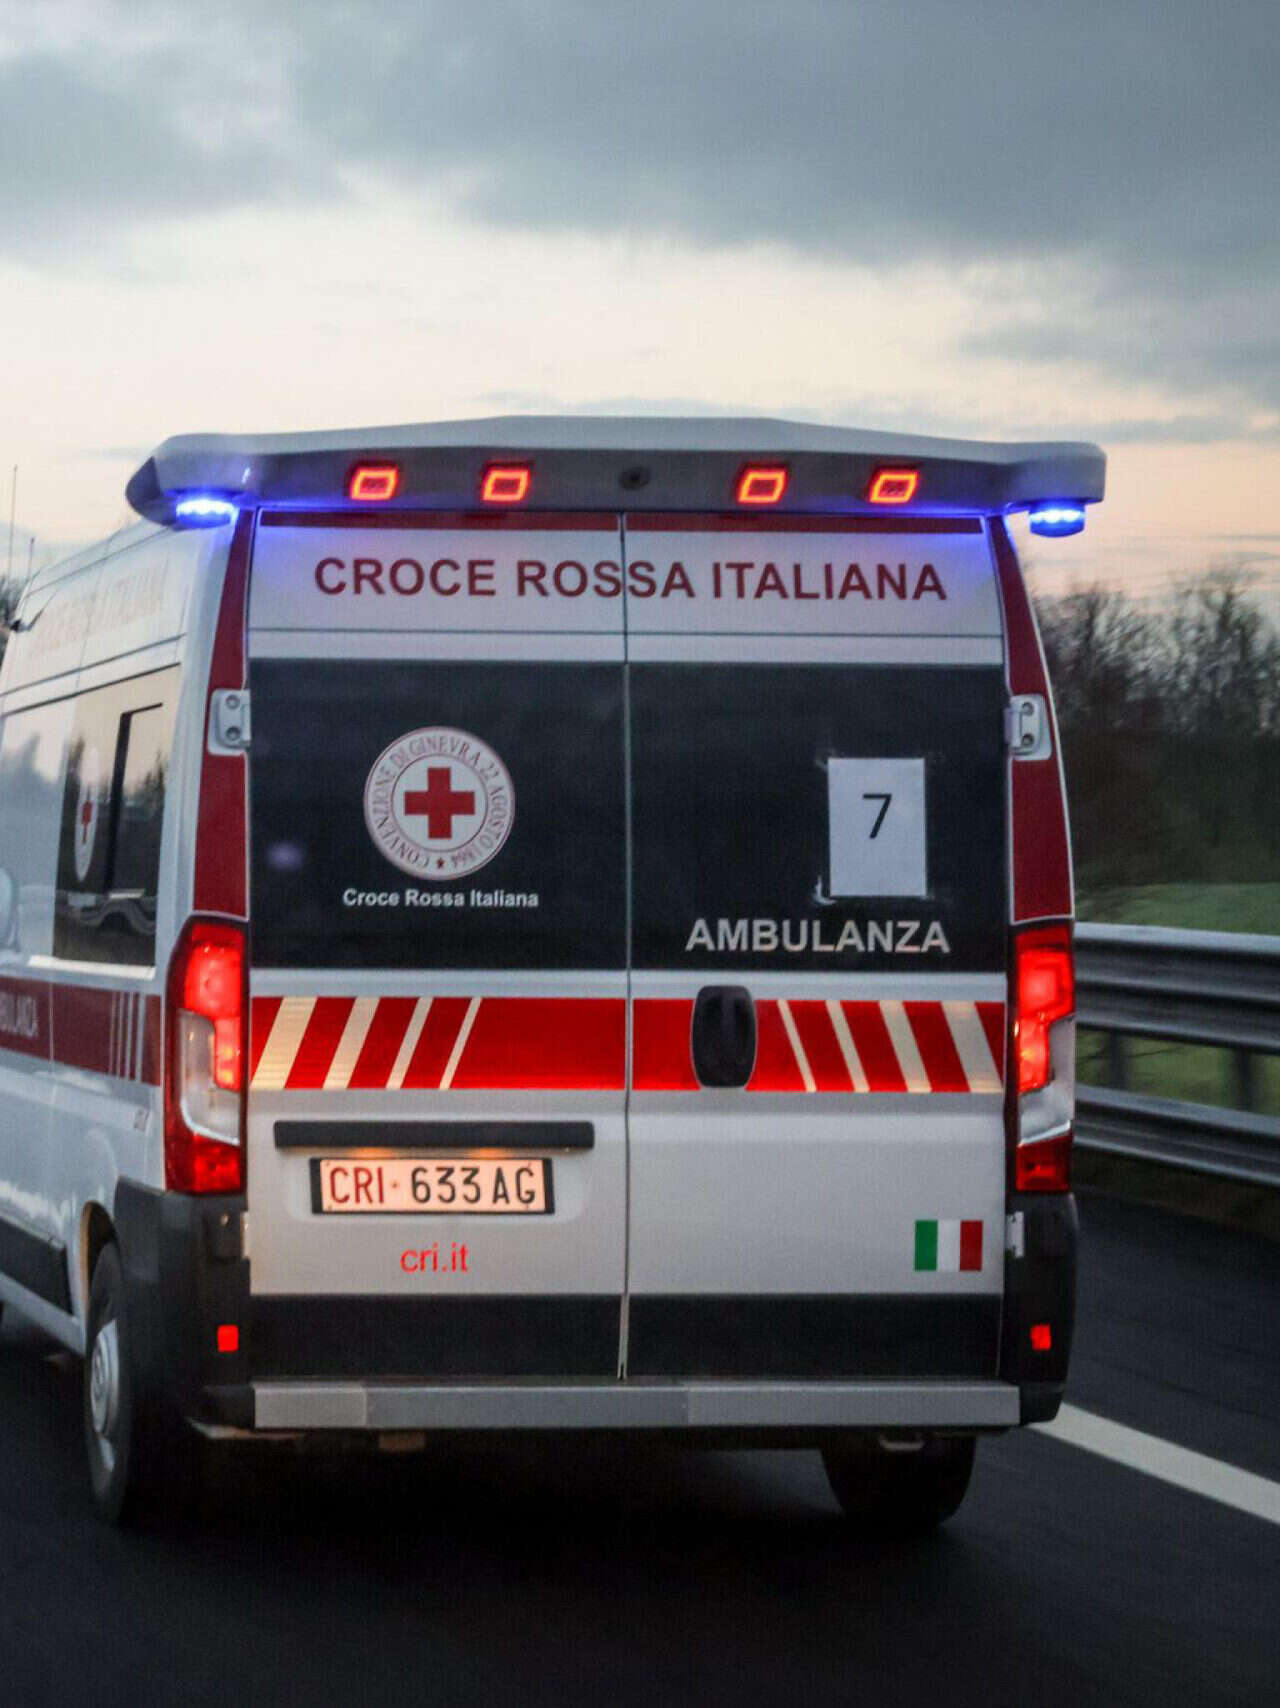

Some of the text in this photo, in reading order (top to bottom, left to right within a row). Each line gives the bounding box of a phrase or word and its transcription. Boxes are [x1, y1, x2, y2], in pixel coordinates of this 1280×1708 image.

[314, 557, 947, 600] CROCE ROSSA ITALIANA
[862, 793, 892, 839] 7
[342, 888, 540, 908] Croce Rossa Italiana
[685, 917, 950, 953] AMBULANZA
[329, 1166, 385, 1205] CRI
[400, 1242, 469, 1273] cri.it
